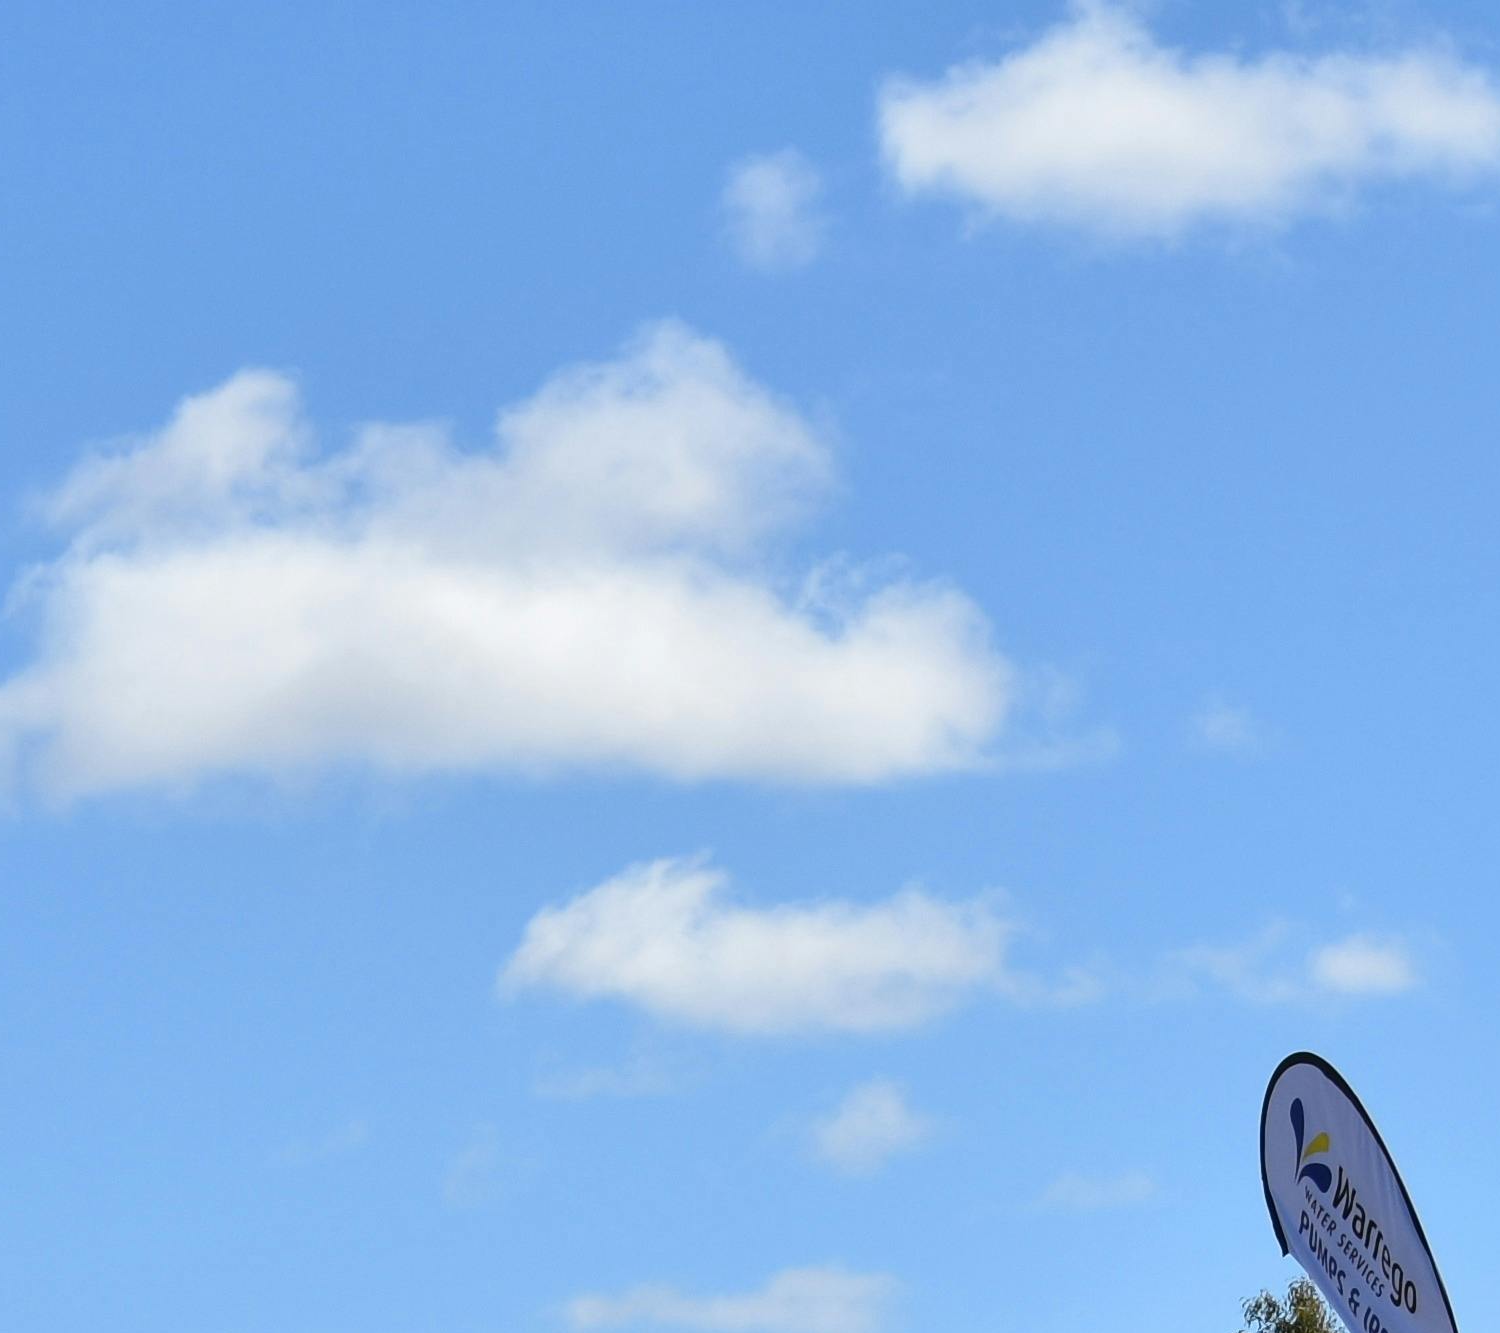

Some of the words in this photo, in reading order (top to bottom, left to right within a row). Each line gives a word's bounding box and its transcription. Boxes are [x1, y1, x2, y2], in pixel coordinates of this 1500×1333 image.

[1298, 1210, 1345, 1297] PUMPS
[1347, 1287, 1361, 1317] &
[1304, 1185, 1336, 1231] WATER
[1337, 1232, 1384, 1299] SERVICES
[1331, 1165, 1417, 1315] Warrego
